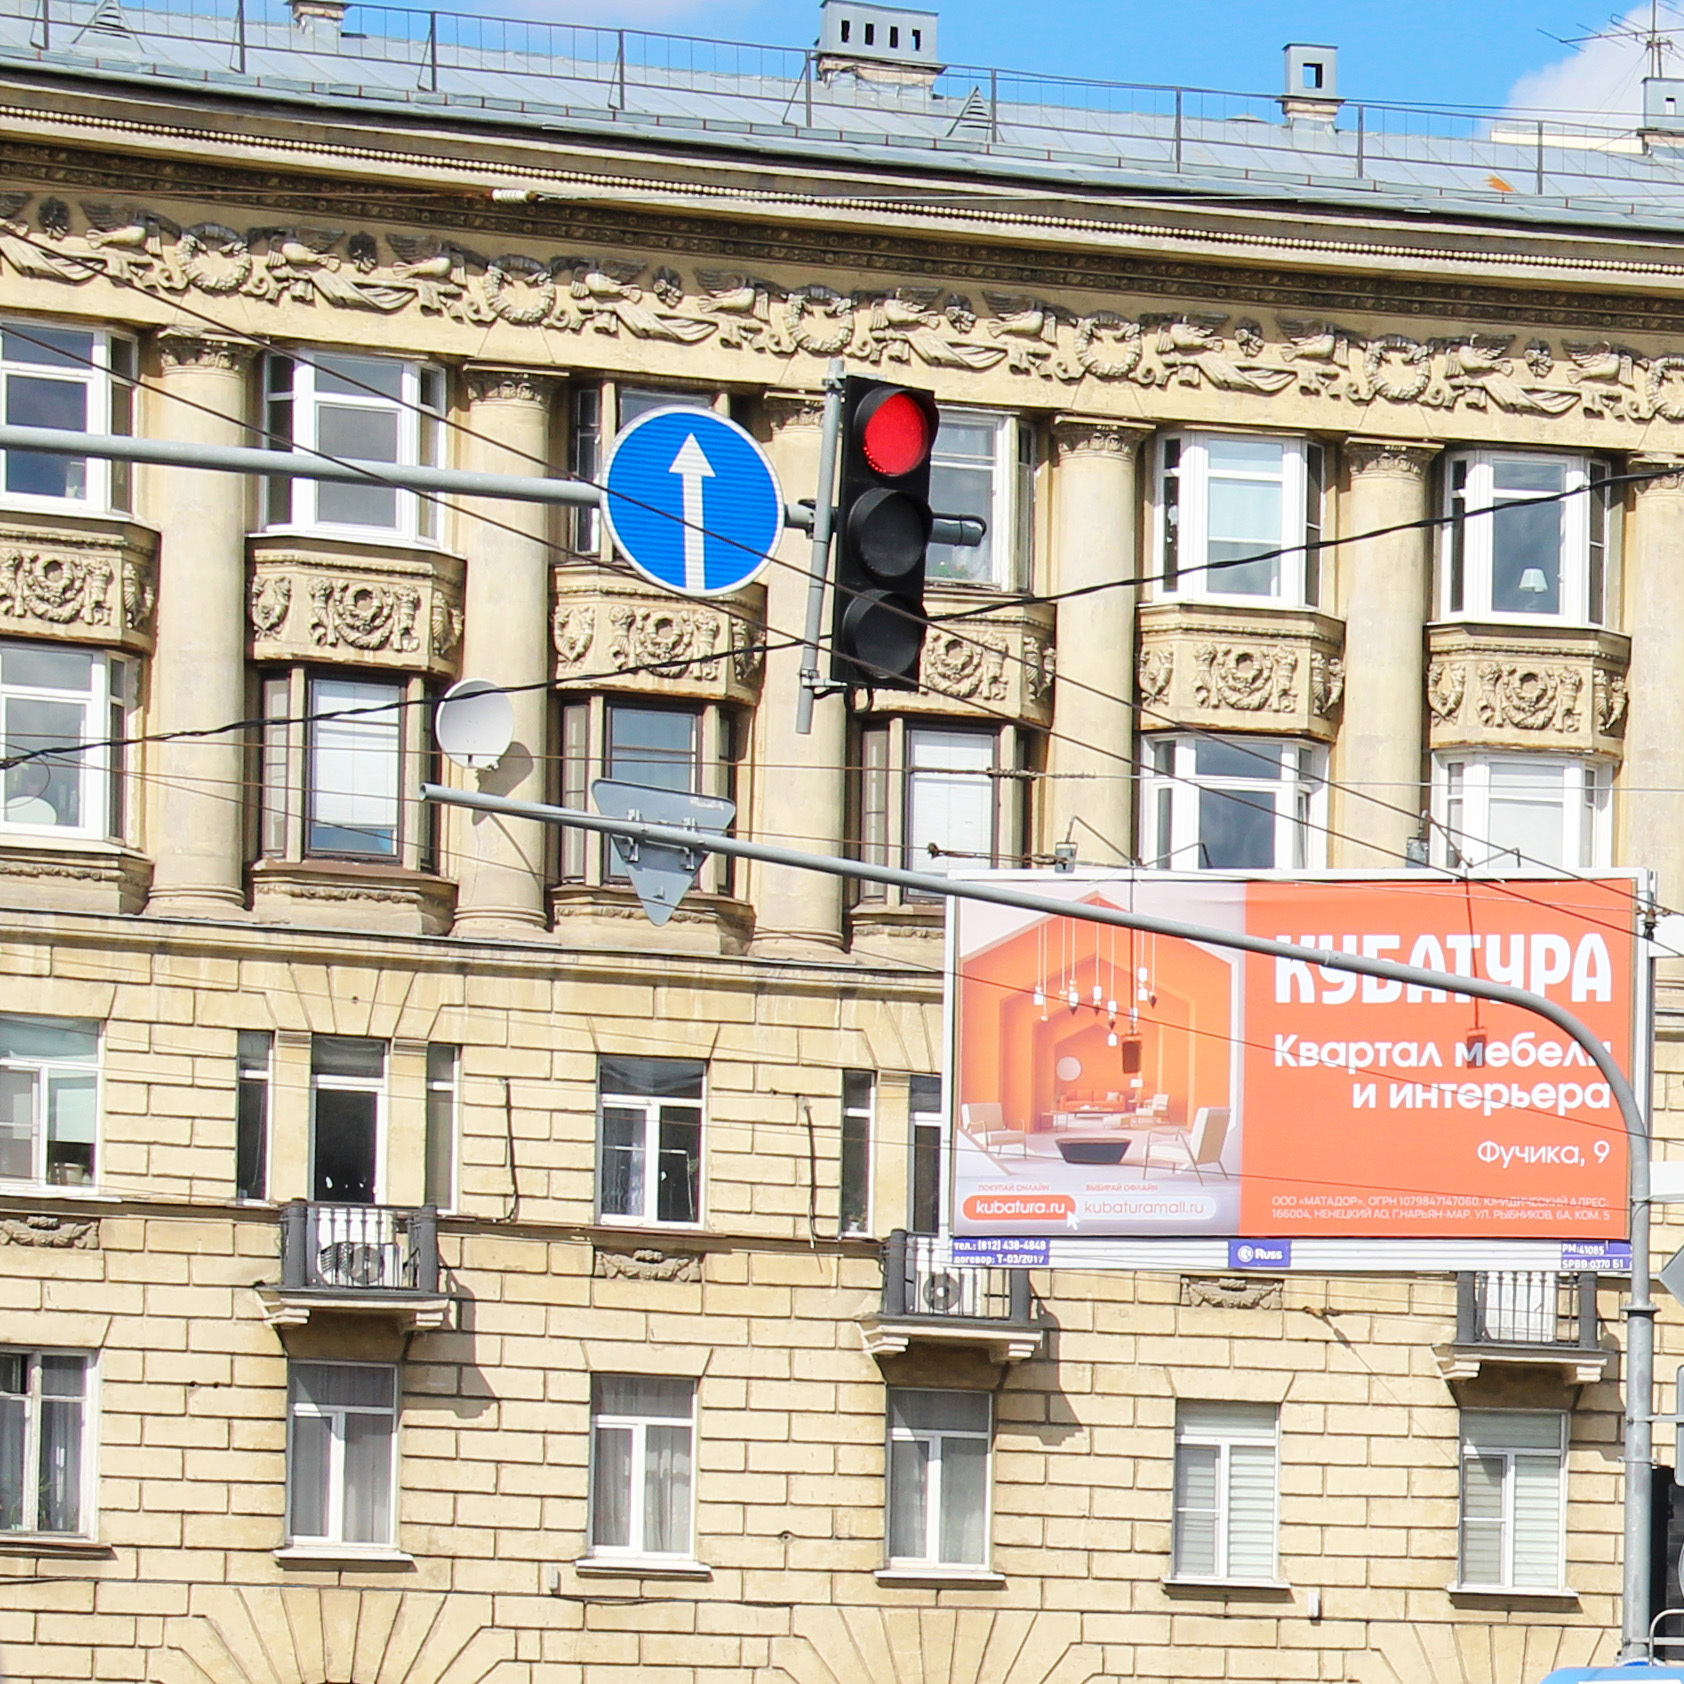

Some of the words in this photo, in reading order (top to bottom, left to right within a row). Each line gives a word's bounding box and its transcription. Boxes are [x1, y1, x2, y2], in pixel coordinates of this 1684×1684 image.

[1274, 933, 1613, 1005] КУБАТУРА
[1274, 1033, 1443, 1074] Квартал
[1353, 1083, 1377, 1109] и
[1389, 1082, 1611, 1117] интерьера
[1477, 1140, 1586, 1169] Фучика,
[1593, 1140, 1611, 1164] 9
[1123, 1184, 1158, 1192] ОФЛАЙН
[975, 1200, 1066, 1215] kubatura.ru
[1084, 1201, 1205, 1215] kubaturamall.ru
[1271, 1195, 1297, 1207] ООО
[1368, 1195, 1398, 1207] ОГРН
[1314, 1207, 1372, 1220] НЕНЕЦКИЙ
[1474, 1209, 1491, 1220] УЛ.
[1574, 1210, 1602, 1221] КОМ.
[1603, 1210, 1610, 1221] 5
